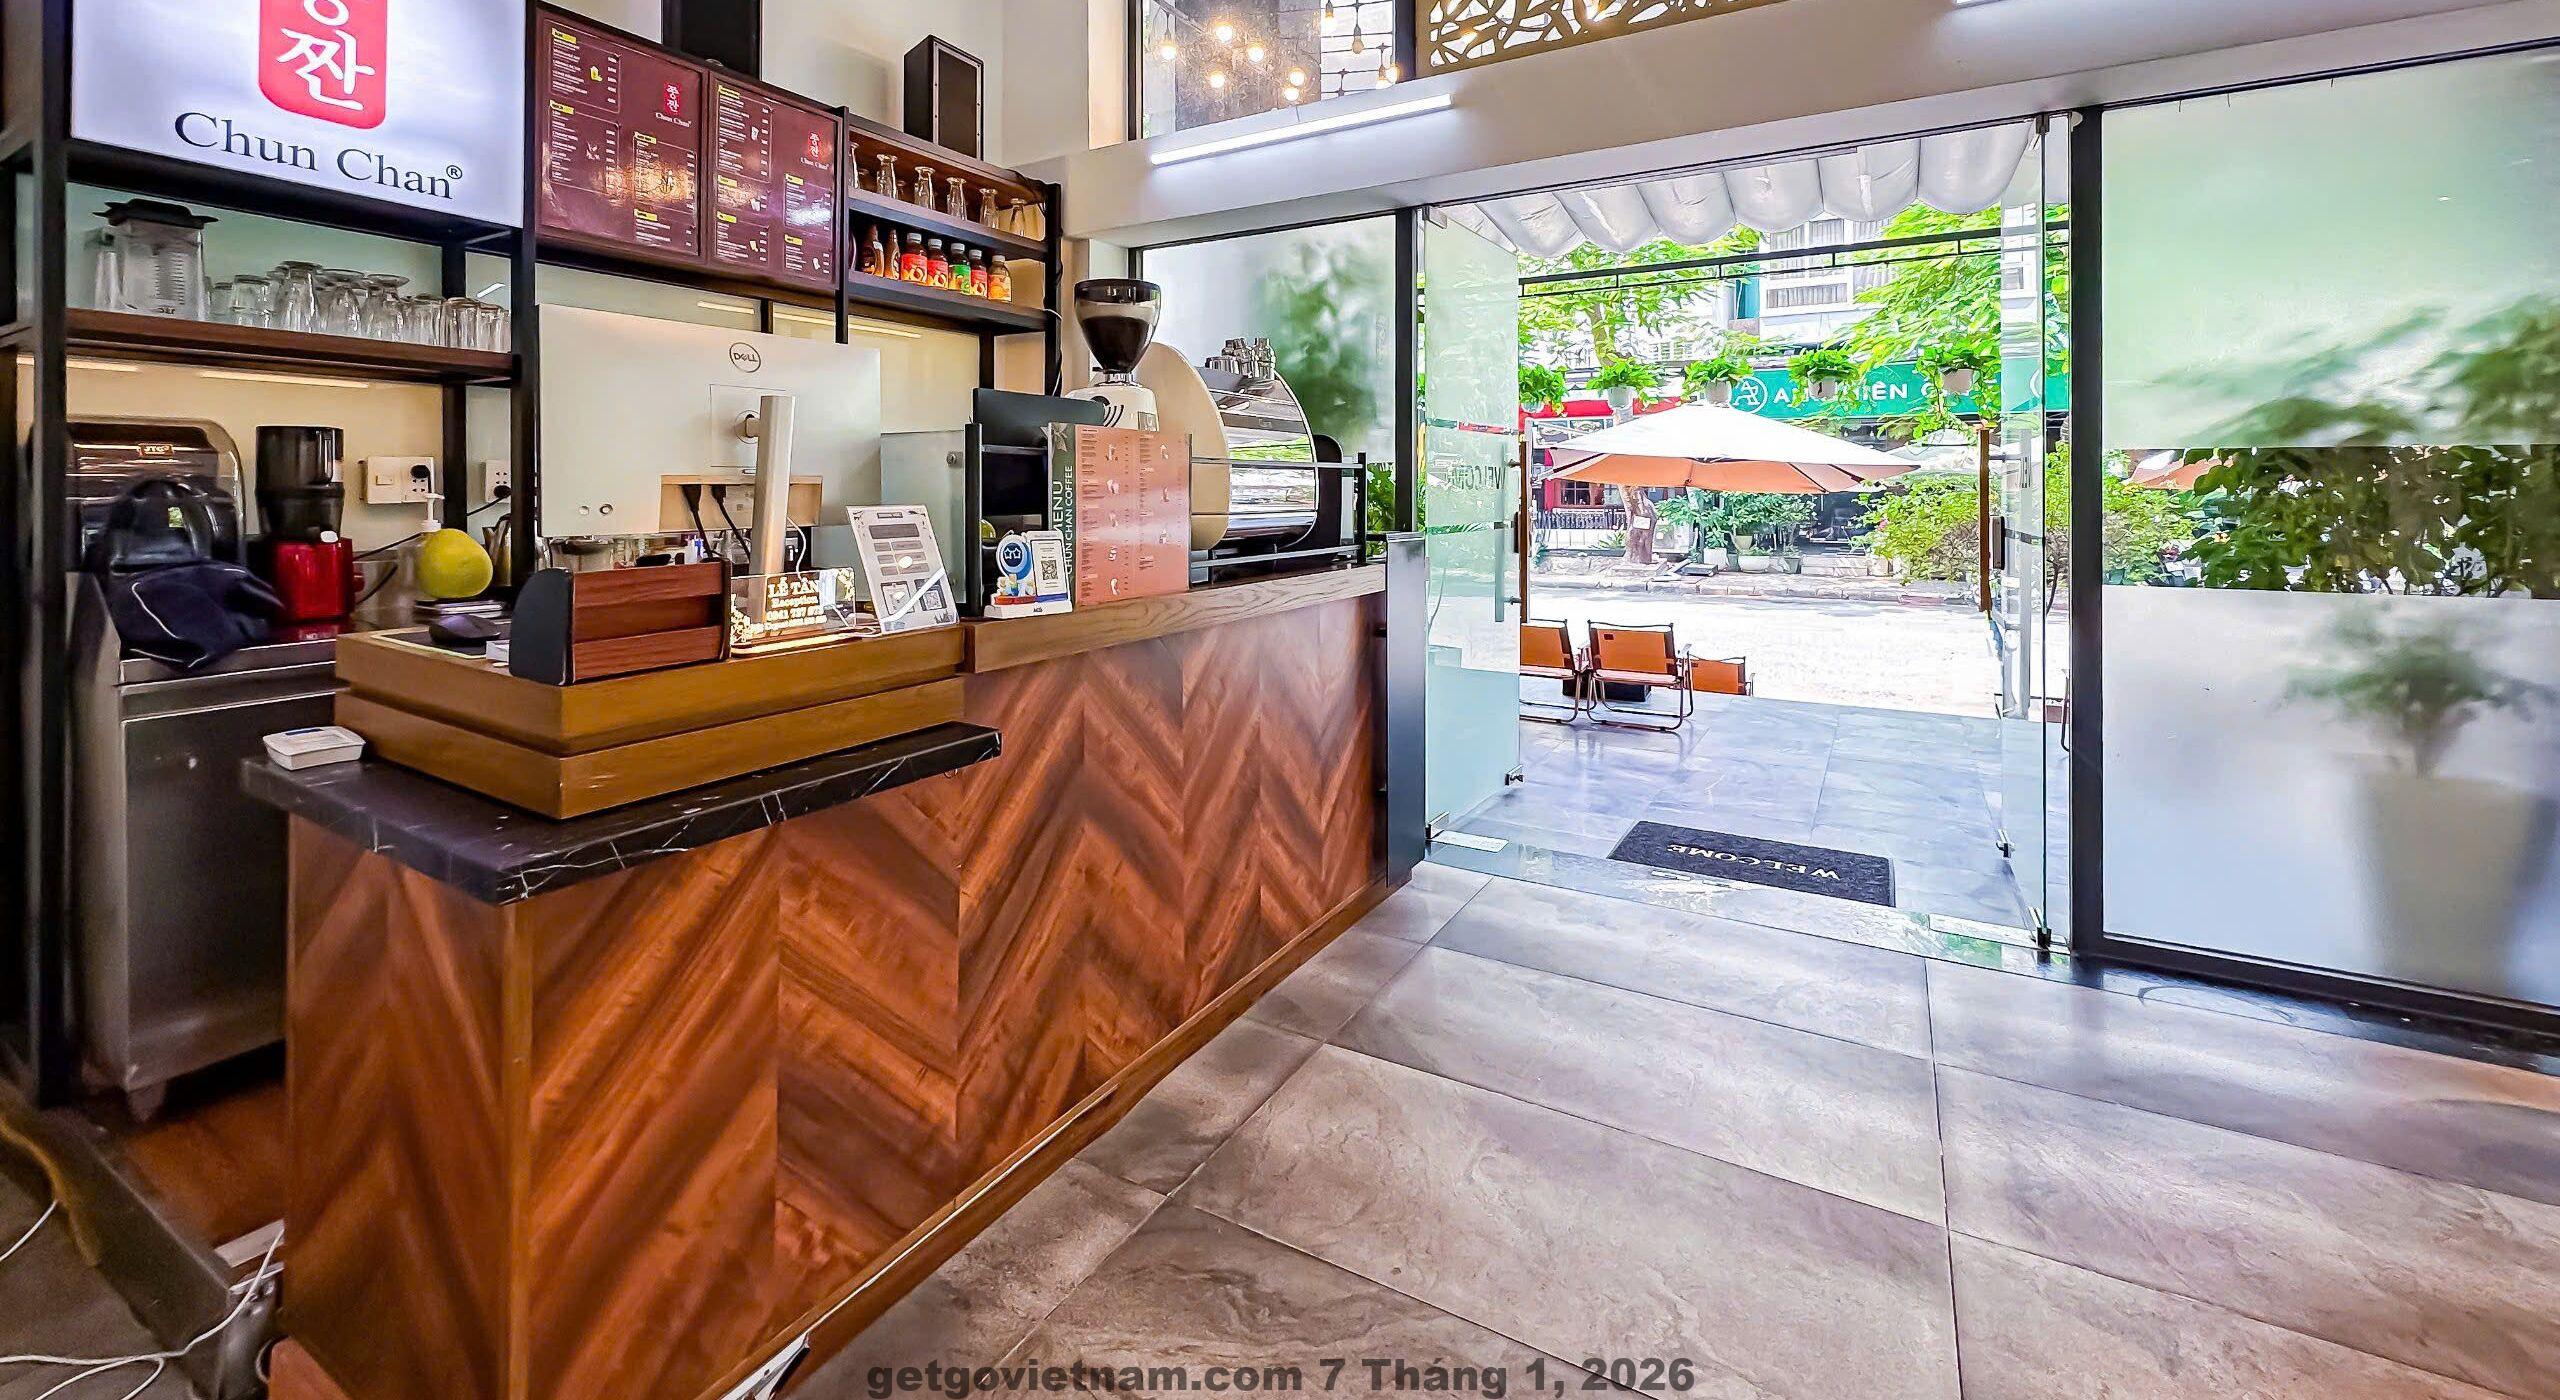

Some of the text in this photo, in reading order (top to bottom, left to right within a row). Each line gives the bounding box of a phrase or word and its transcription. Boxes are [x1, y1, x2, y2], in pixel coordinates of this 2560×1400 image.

[174, 112, 319, 171] Chun
[733, 352, 758, 362] DELL
[1065, 465, 1073, 507] COFFEE
[1065, 509, 1073, 540] CHAN
[1666, 844, 1841, 880] WELCOME
